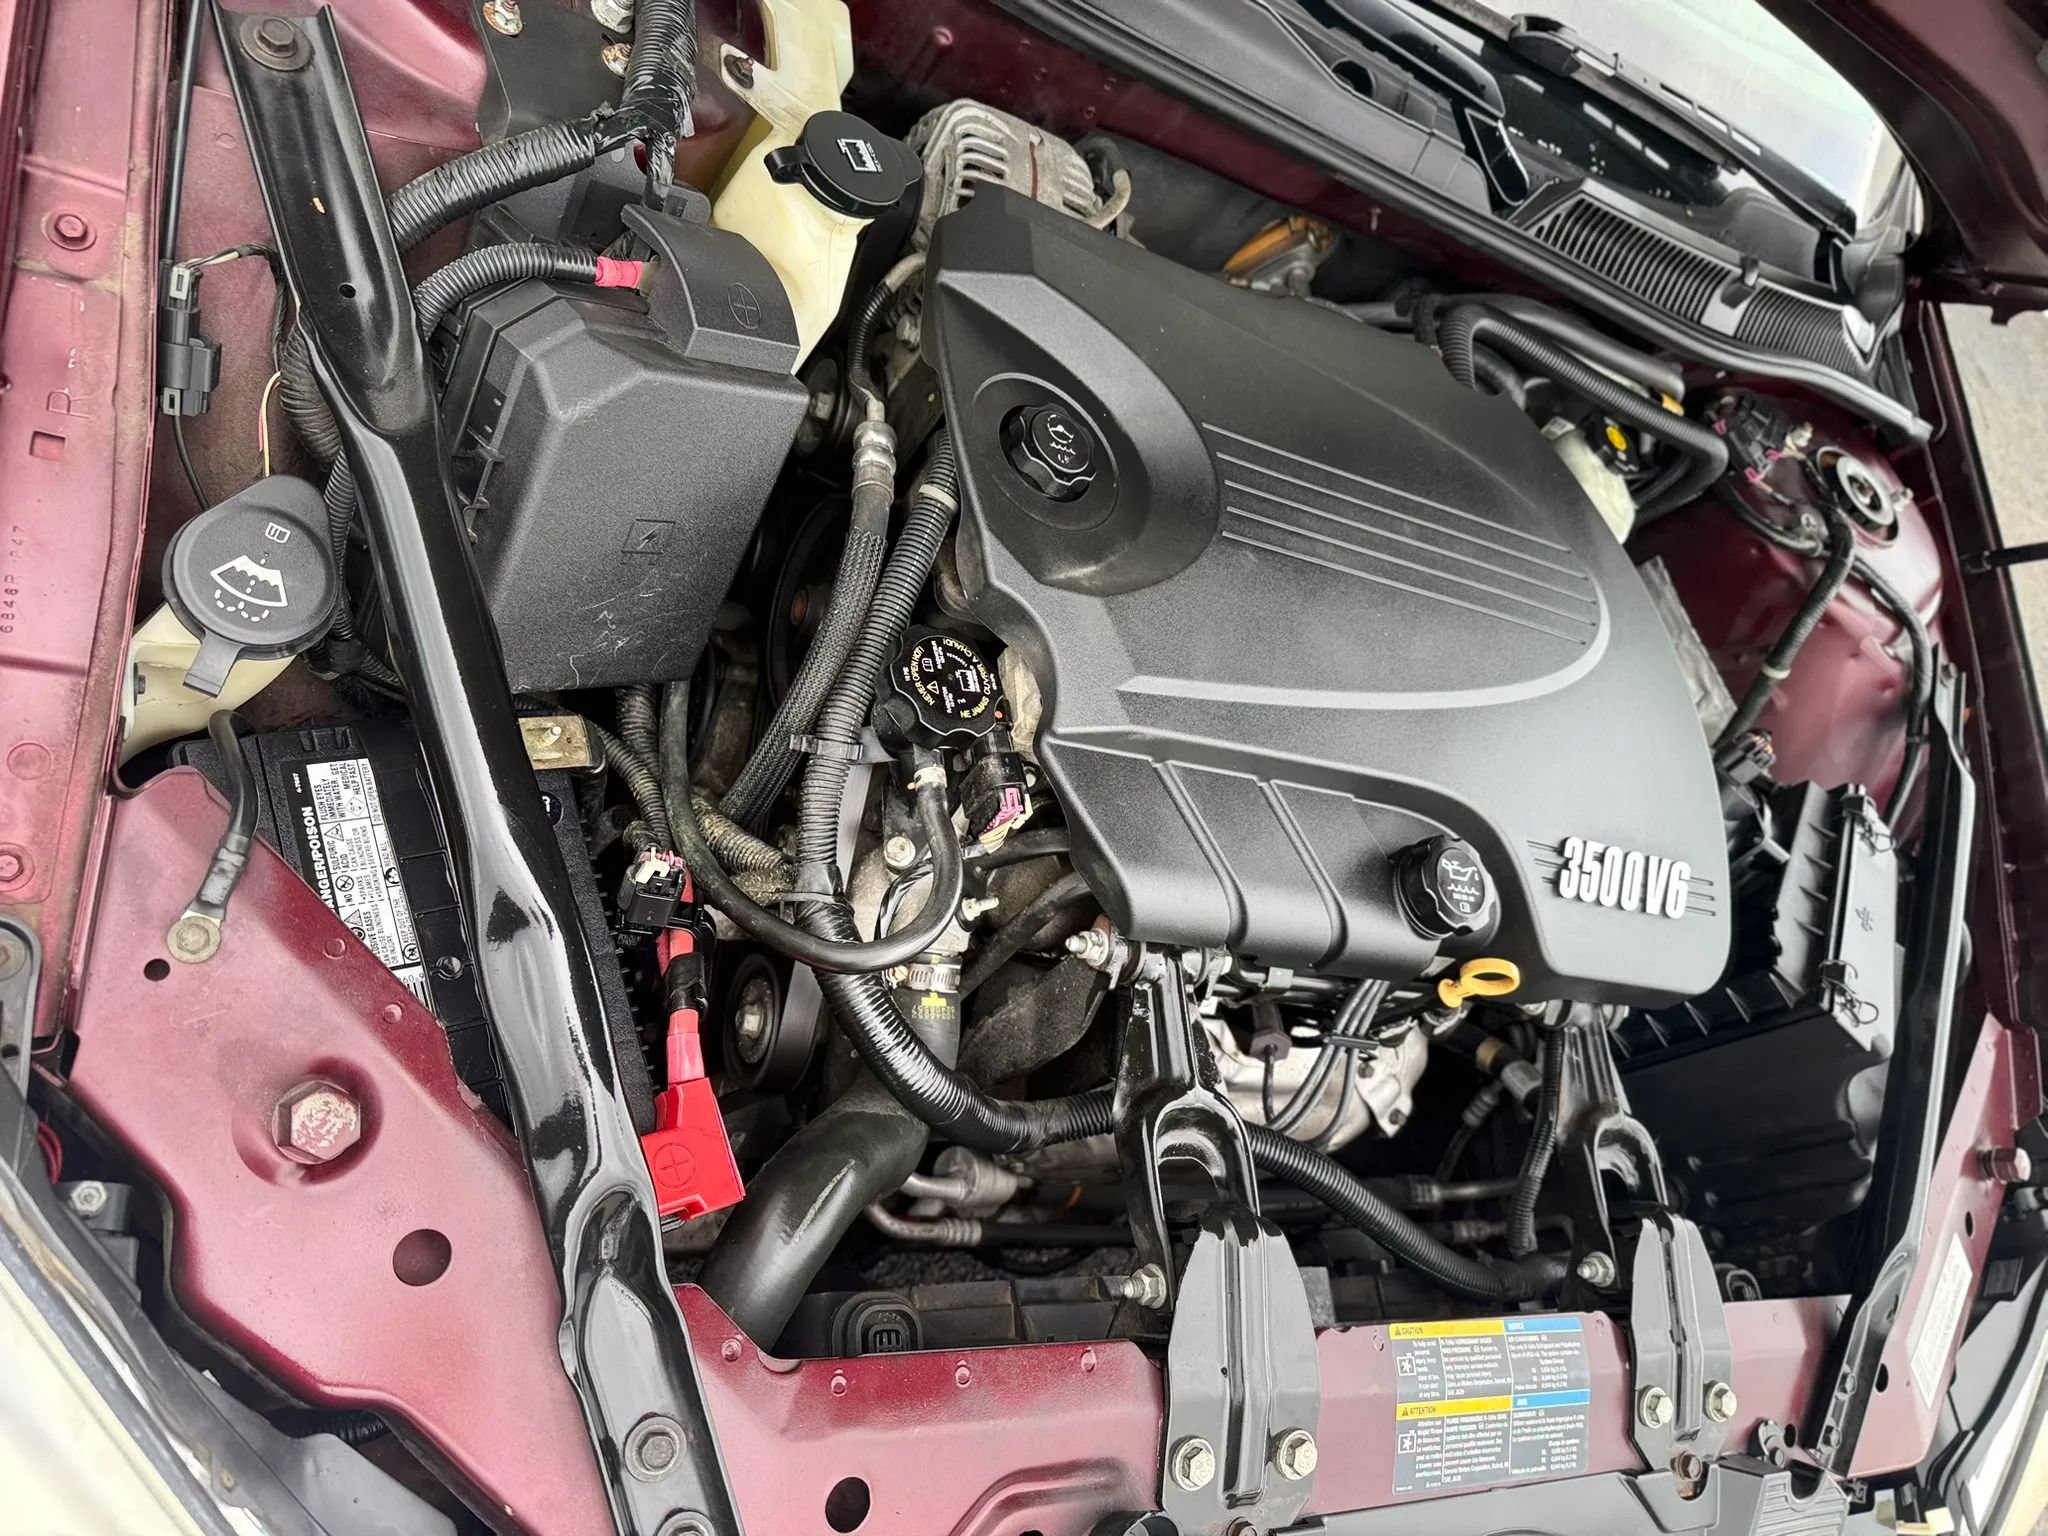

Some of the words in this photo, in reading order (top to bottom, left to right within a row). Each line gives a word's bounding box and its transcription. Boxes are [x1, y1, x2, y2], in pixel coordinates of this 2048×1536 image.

[912, 645, 925, 662] HOT!
[943, 638, 972, 657] CHAUD!
[910, 661, 919, 681] OPEN
[914, 680, 936, 706] NEVER
[960, 710, 972, 719] NE
[330, 764, 339, 776] GET
[339, 763, 350, 790] MEDICAL
[347, 762, 358, 779] FAST.
[314, 784, 324, 800] EYES
[330, 778, 342, 802] WATER.
[350, 780, 361, 795] HELP
[321, 778, 338, 820] IMMEDIATELY
[318, 802, 329, 820] FLUSH
[336, 802, 346, 818] WITH
[302, 806, 335, 908] ANGER/POISON
[327, 840, 341, 870] SULFURIC
[340, 854, 350, 868] ACID
[344, 894, 354, 903] NO
[363, 910, 375, 931] GASES
[368, 932, 381, 958] LOSIVE
[400, 930, 409, 943] KEEP
[1402, 1326, 1424, 1335] CAUTION
[1410, 1406, 1436, 1415] ATTENTION
